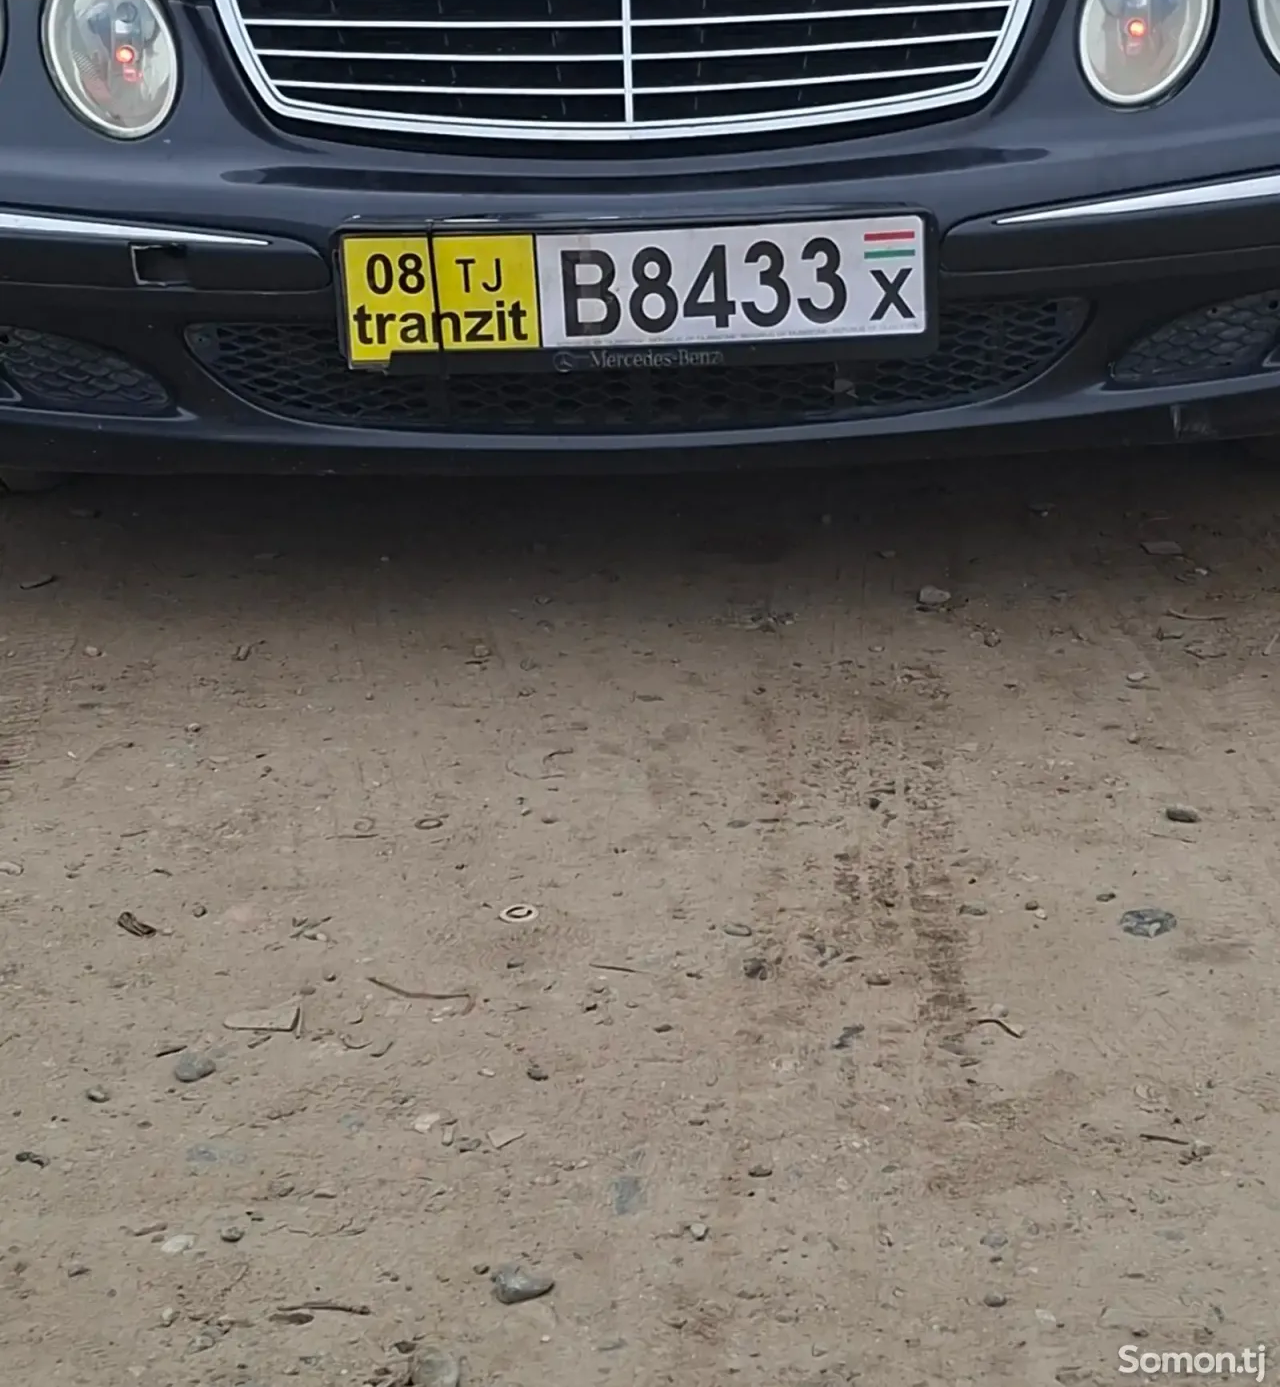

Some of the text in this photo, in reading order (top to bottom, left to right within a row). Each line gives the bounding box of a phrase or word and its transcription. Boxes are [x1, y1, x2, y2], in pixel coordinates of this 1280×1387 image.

[366, 252, 503, 295] 08 TJ
[560, 236, 848, 337] B8433
[353, 300, 528, 345] tranzit
[588, 348, 723, 369] Mercedes-Benz
